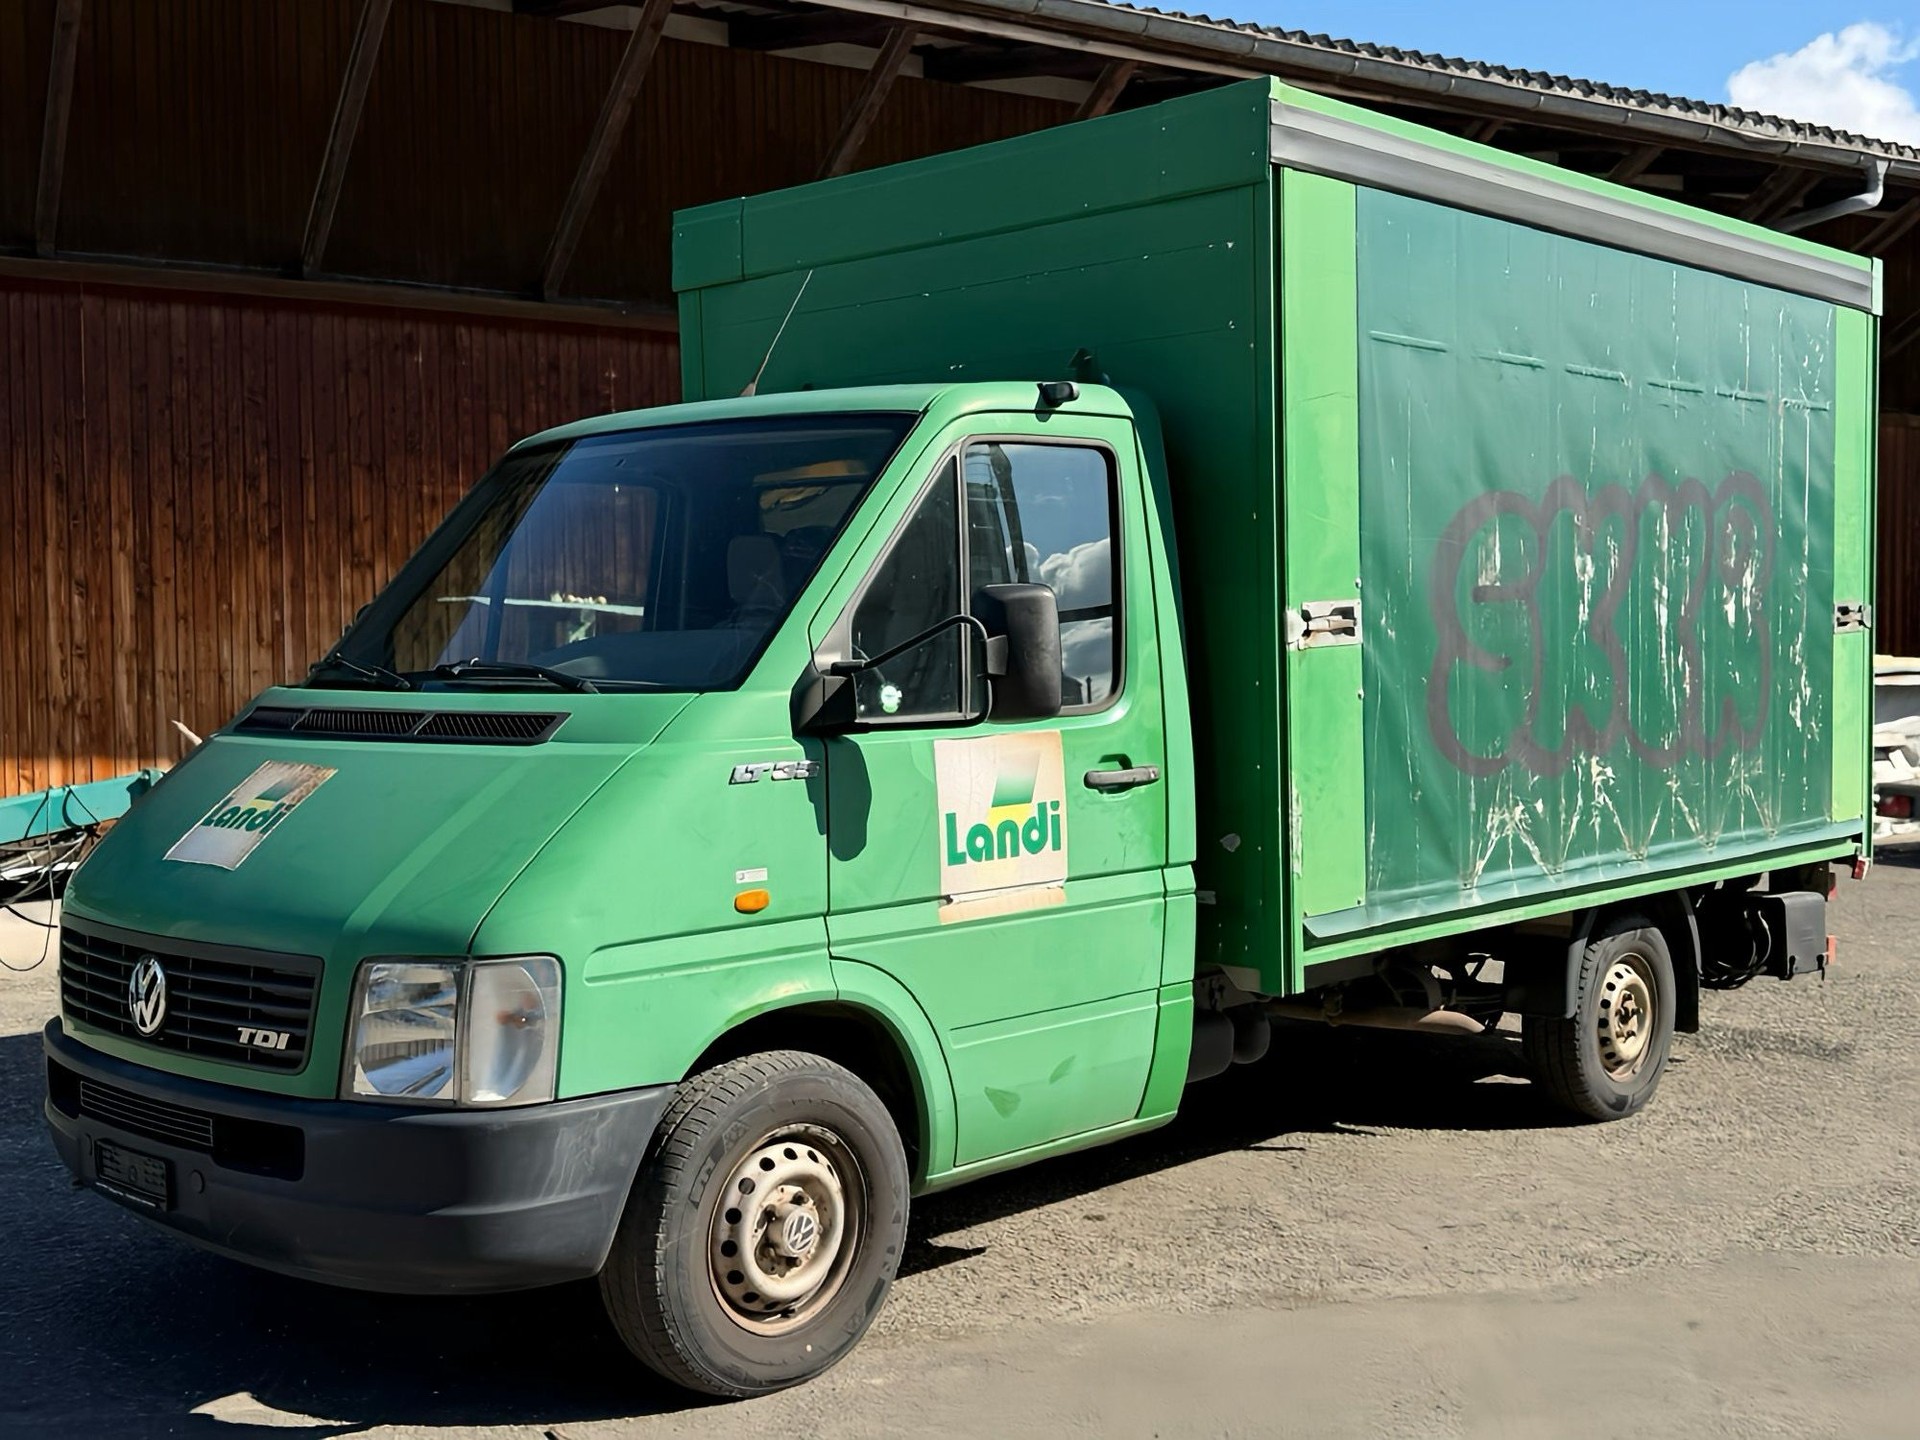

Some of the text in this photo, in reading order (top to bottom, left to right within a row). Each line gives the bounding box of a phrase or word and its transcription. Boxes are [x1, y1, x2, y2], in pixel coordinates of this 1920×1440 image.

[200, 796, 296, 834] Landi
[945, 800, 1062, 866] Landi
[237, 1026, 290, 1050] TDI
